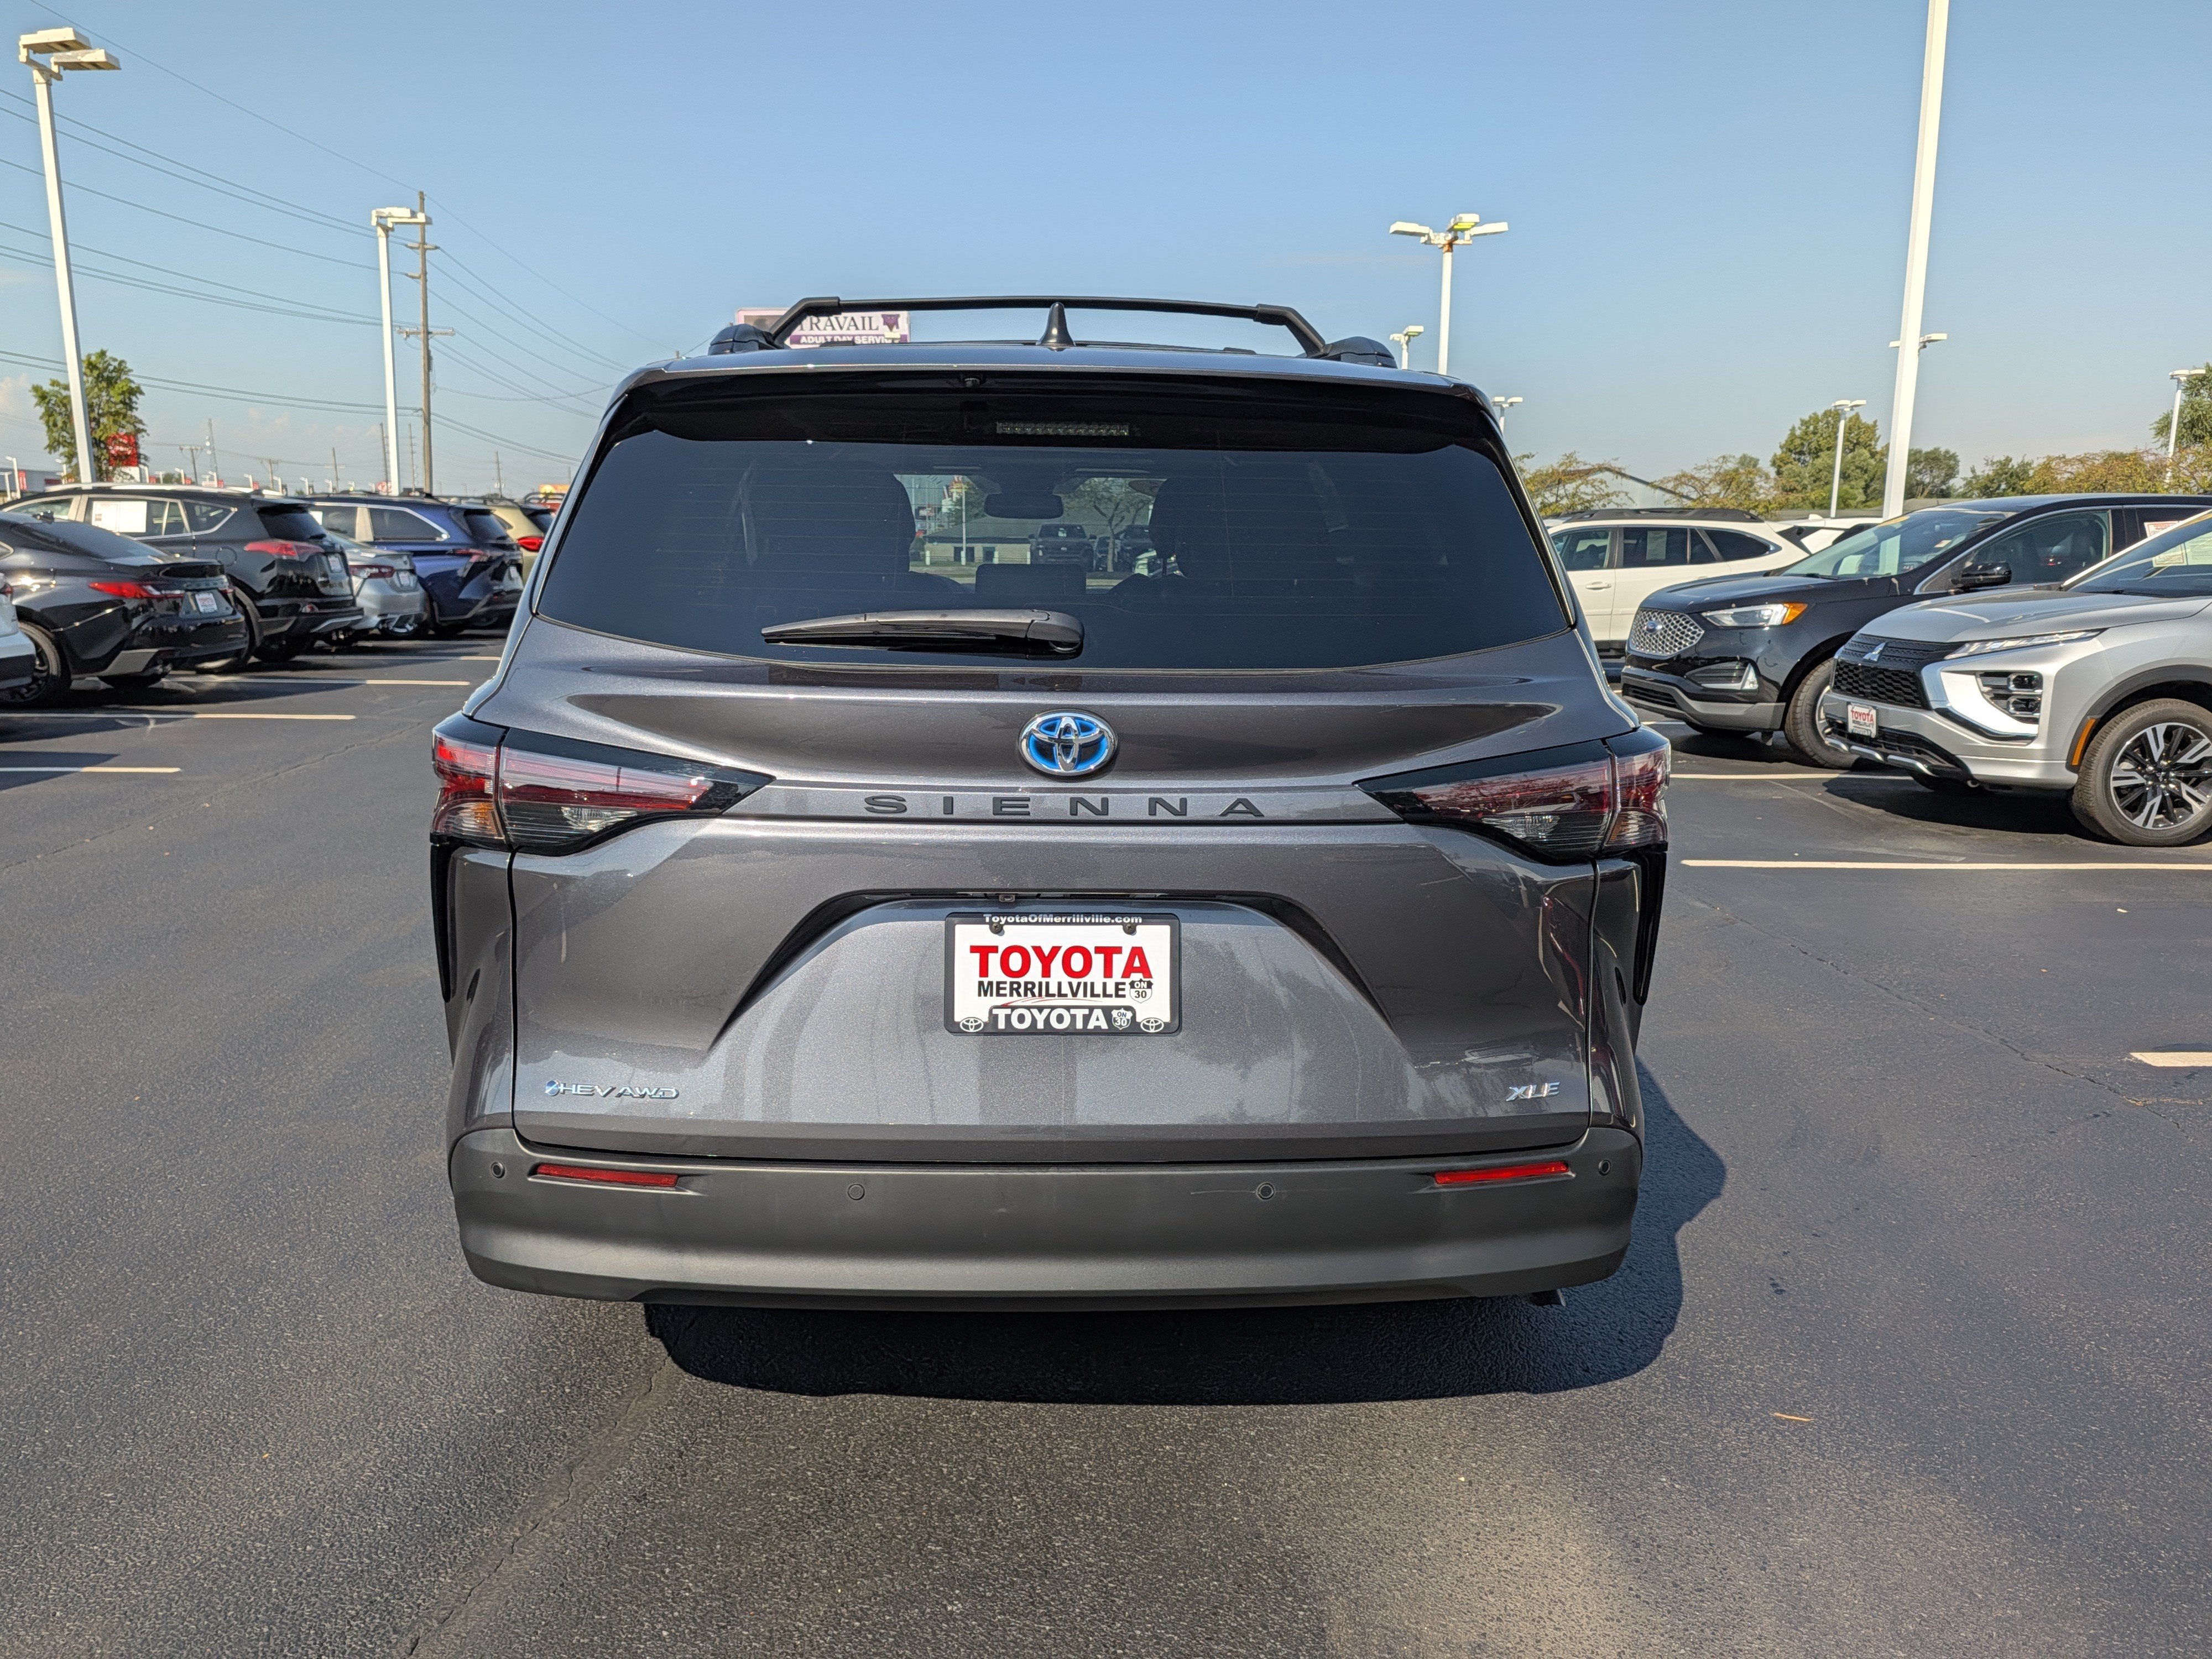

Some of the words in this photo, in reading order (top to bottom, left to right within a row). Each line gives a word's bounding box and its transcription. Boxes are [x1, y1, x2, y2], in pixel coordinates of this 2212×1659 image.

[1851, 709, 1874, 723] TOYOTA
[864, 796, 1265, 817] SIENNA
[983, 914, 1142, 925] ToyotaOfMerrillville.com
[969, 945, 1153, 979] TOYOTA
[978, 980, 1126, 999] MERRILLVILLE
[1134, 990, 1147, 999] 30
[992, 1008, 1109, 1030] TOYOTA
[1115, 1018, 1127, 1026] 30
[559, 1082, 615, 1098] HEV
[615, 1086, 680, 1099] AWD
[1506, 1082, 1561, 1101] XLE
